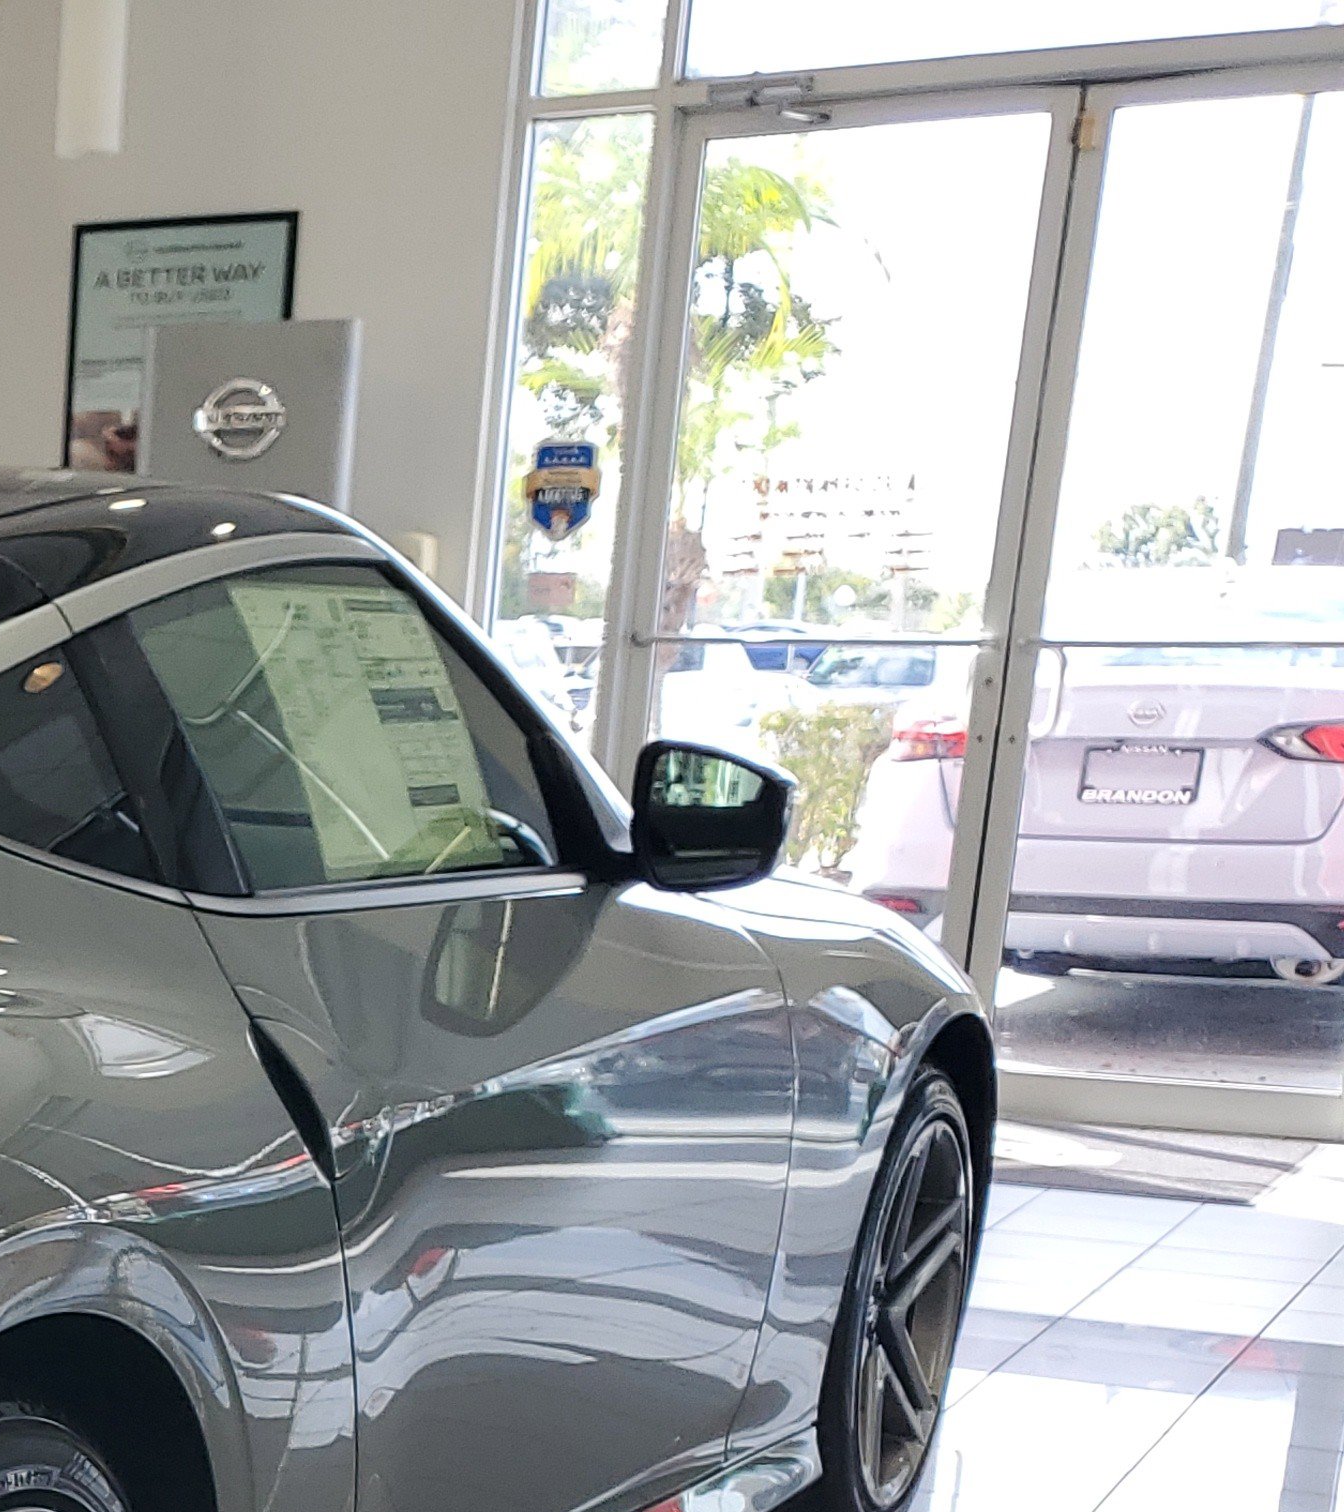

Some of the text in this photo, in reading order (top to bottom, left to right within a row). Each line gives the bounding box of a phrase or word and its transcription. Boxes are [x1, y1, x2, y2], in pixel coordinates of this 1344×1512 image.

[93, 261, 265, 289] A BETTER WAY
[1081, 788, 1192, 805] BRANDON
